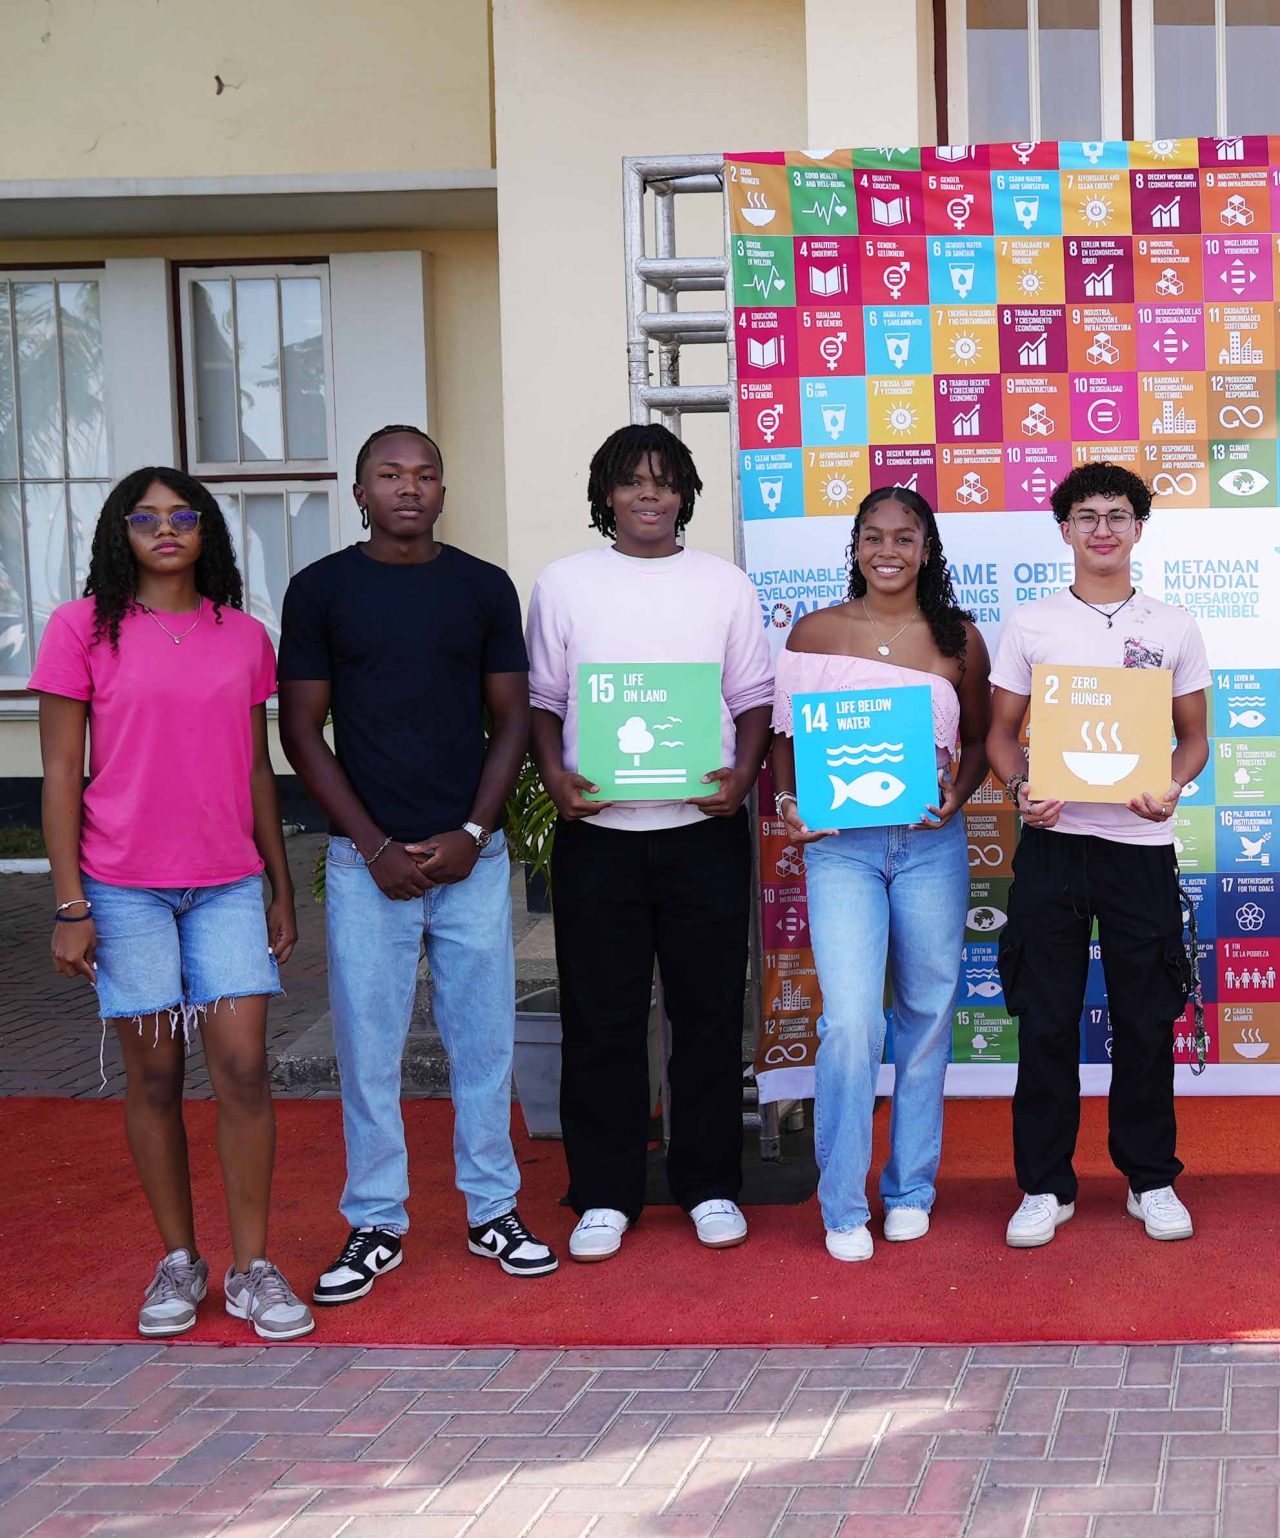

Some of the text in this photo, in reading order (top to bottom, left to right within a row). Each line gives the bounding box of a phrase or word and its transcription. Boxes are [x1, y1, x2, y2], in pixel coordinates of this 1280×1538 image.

[860, 174, 868, 188] 4
[929, 176, 936, 189] 5
[997, 176, 1005, 189] 6
[1136, 174, 1144, 188] 8
[1069, 241, 1078, 256] 8
[739, 313, 747, 328] 4
[752, 312, 777, 320] EDUCACIÓN
[803, 312, 811, 327] 5
[824, 318, 843, 327] GÉNERO
[1003, 310, 1011, 324] 8
[760, 320, 777, 328] CALIDAD
[1015, 324, 1044, 332] ECONÓMICO
[1212, 444, 1225, 460] 13
[1229, 444, 1249, 452] CLIMATE
[1230, 452, 1247, 460] ACTION
[1164, 560, 1259, 573] METANAN
[1164, 575, 1259, 589] MUNDIAL
[757, 585, 845, 601] EVELOPMENT
[1016, 588, 1037, 600] DE
[1165, 592, 1259, 604] PA DESAROYO
[1189, 605, 1259, 618] STENIBEL
[624, 674, 643, 685] LIFE
[1071, 676, 1097, 689] ZERO
[588, 674, 614, 702] 15
[1045, 675, 1058, 704] 2
[624, 690, 667, 702] ON LAND
[1071, 693, 1112, 706] HUNGER
[836, 698, 891, 714] LIFE BELOW
[802, 703, 829, 732] 14
[838, 716, 871, 730] WATER
[1222, 878, 1233, 892] 17
[1089, 946, 1100, 959] 16
